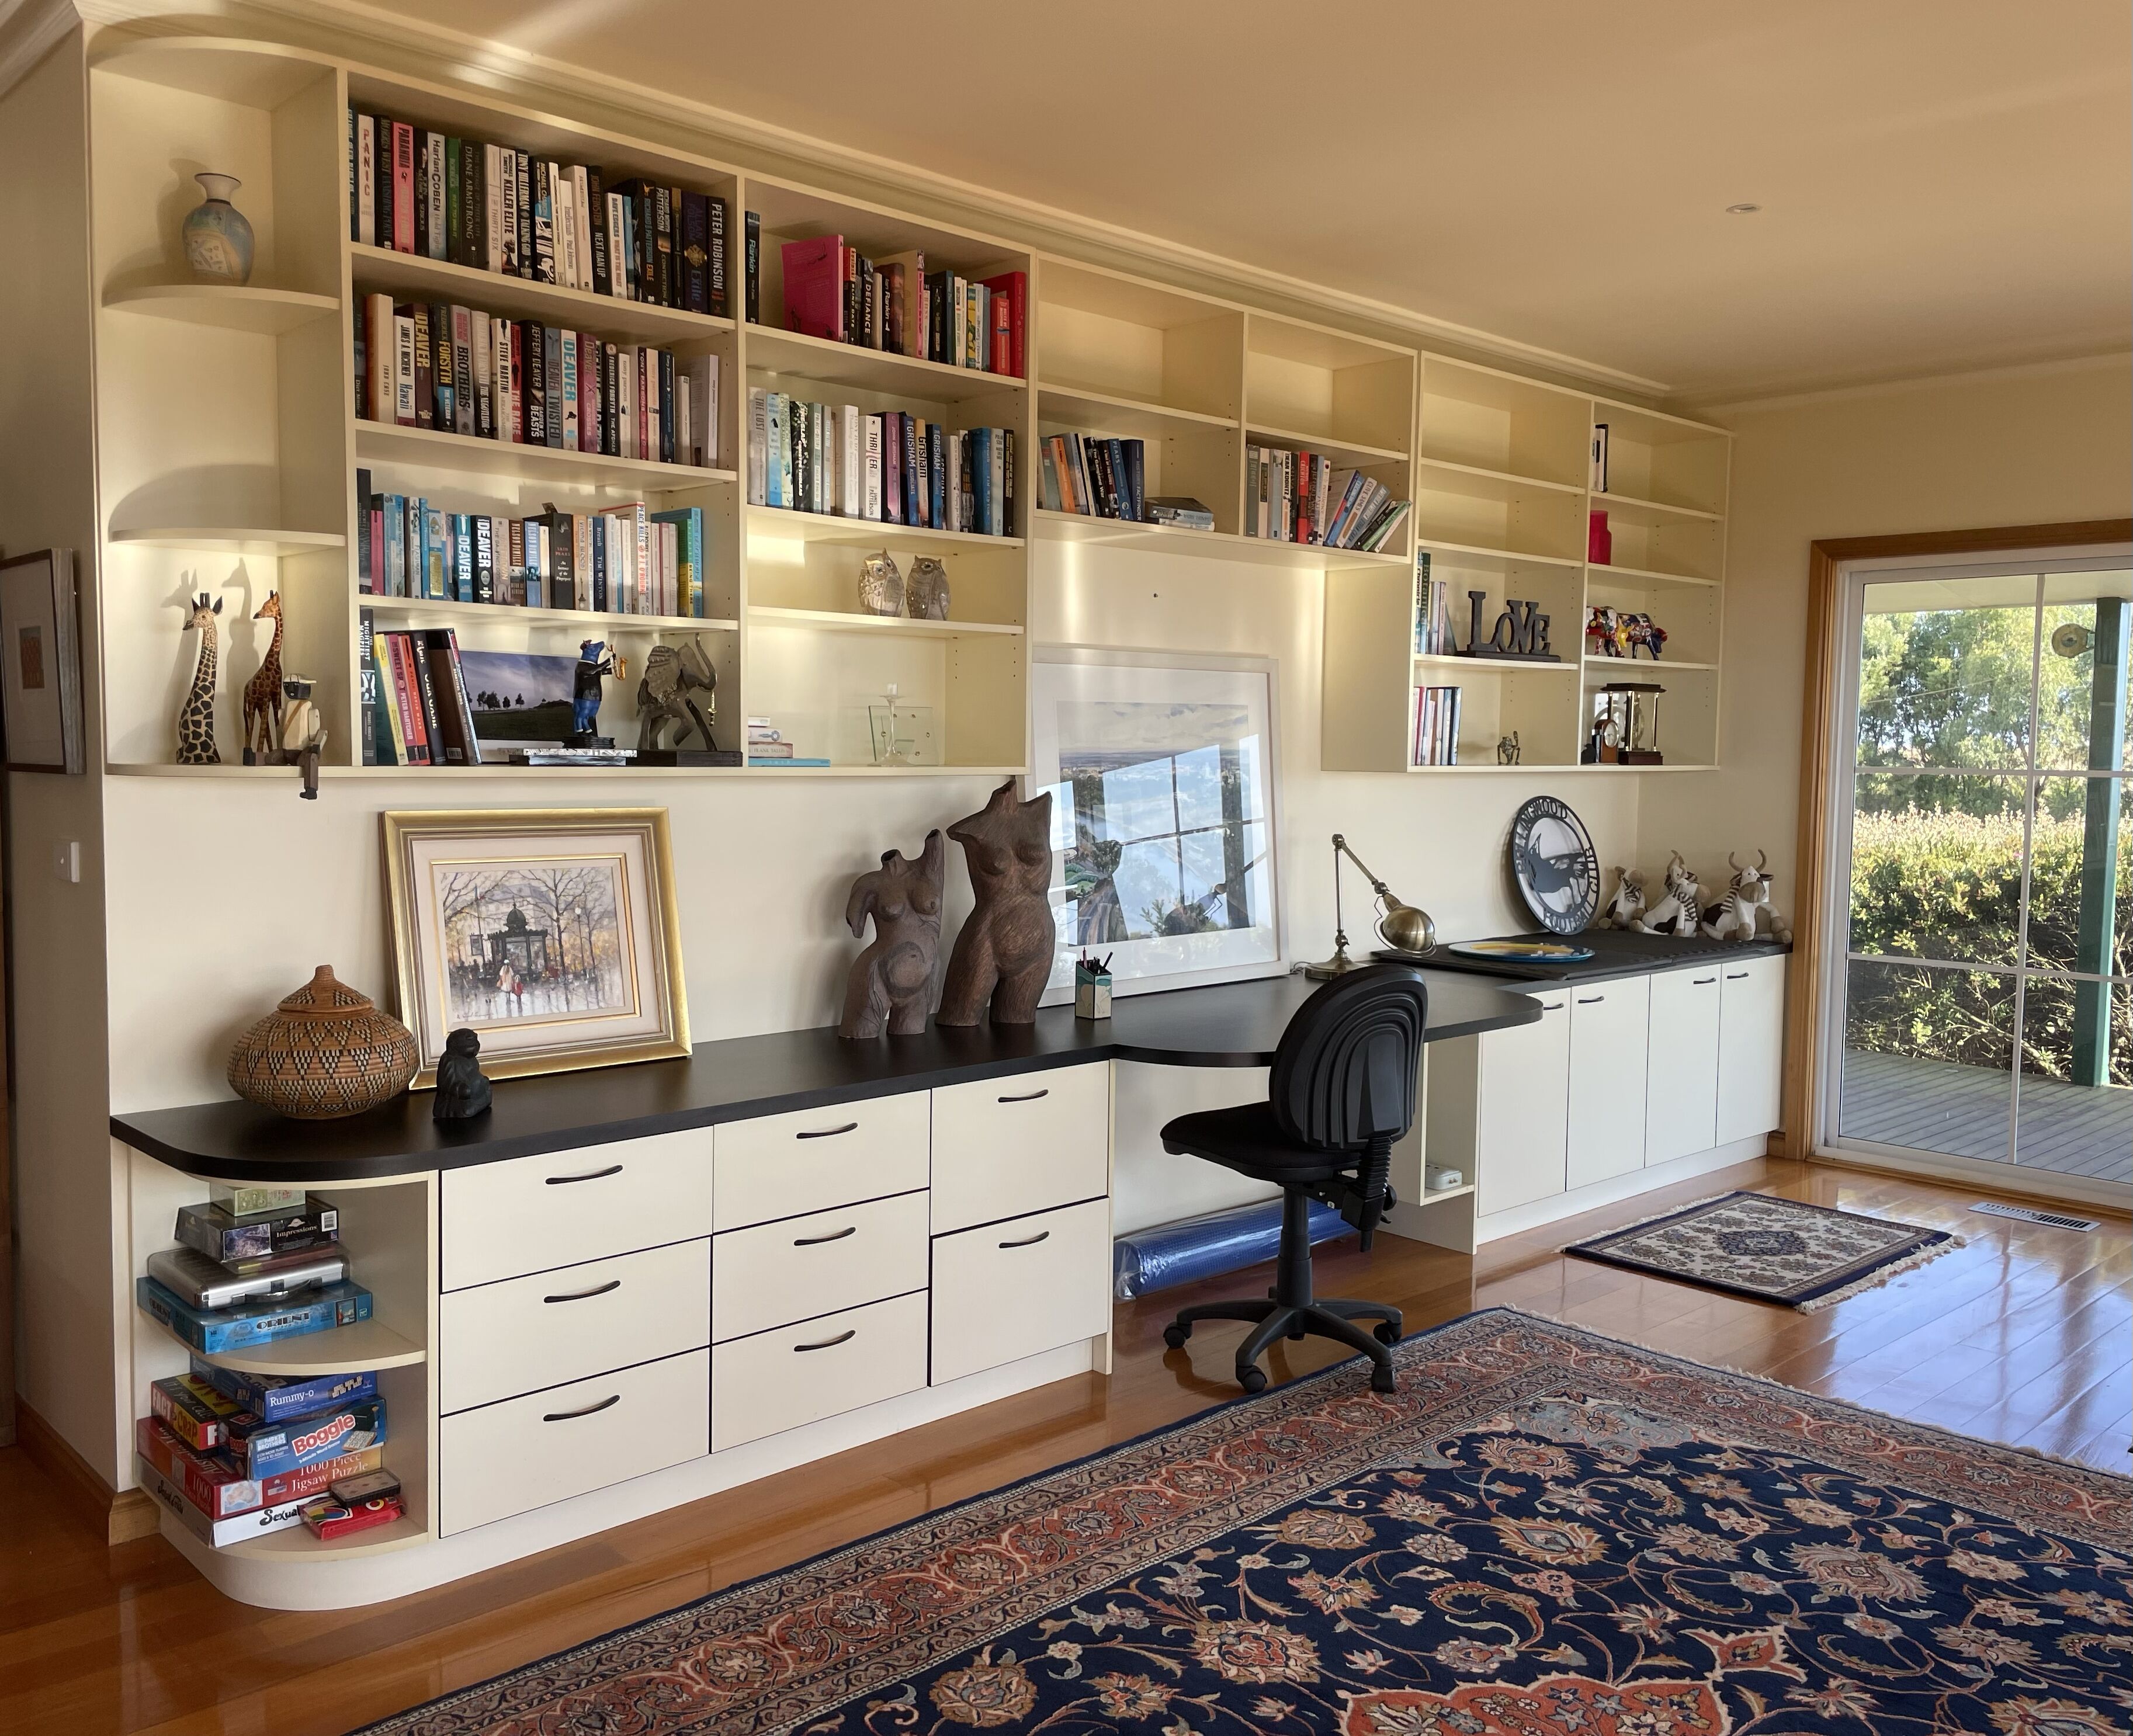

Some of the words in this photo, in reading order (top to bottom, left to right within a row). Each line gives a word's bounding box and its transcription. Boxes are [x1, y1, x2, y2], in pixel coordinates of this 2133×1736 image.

[398, 127, 410, 168] PARANOIA
[518, 154, 528, 171] TONY
[432, 173, 441, 211] COBEN
[504, 179, 514, 209] KILLER
[466, 178, 474, 239] ARMSTRONG
[505, 211, 514, 235] ELITE
[656, 188, 664, 231] PATTERSON
[712, 204, 723, 234] PETER
[595, 232, 604, 249] NEXT
[596, 252, 605, 265] MAN
[597, 266, 605, 277] UP
[713, 238, 723, 289] ROBINSON
[415, 314, 430, 367] DEAVER
[500, 342, 508, 362] STEVE
[531, 325, 542, 357] JEFFERY
[438, 341, 452, 383] FORSYTH
[563, 341, 576, 401] DEAVER
[584, 341, 594, 374] Deaver
[457, 346, 470, 408] BROTHERS
[500, 364, 509, 393] MARTINI
[532, 359, 542, 387] DEAVER
[400, 383, 412, 409] Hawaii
[512, 390, 520, 407] THE
[755, 398, 764, 411] THE
[512, 411, 521, 435] RACE
[530, 405, 539, 437] BEASTS
[549, 396, 560, 439] TWISTED
[755, 413, 765, 431] LOST
[907, 426, 915, 467] GRISHAM
[918, 436, 927, 477] Grisham
[477, 522, 491, 567] DEAVER
[512, 523, 521, 543] NELSON
[528, 523, 537, 543] NELSON
[458, 538, 471, 579] DEAVER
[1466, 590, 1551, 655] LOVE
[393, 648, 403, 669] SWEET
[276, 1225, 318, 1238] Impressions
[256, 1313, 310, 1329] ORIENT
[292, 1415, 356, 1456] Boggle
[292, 1474, 328, 1492] Jigsaw
[332, 1461, 368, 1479] Puzzle
